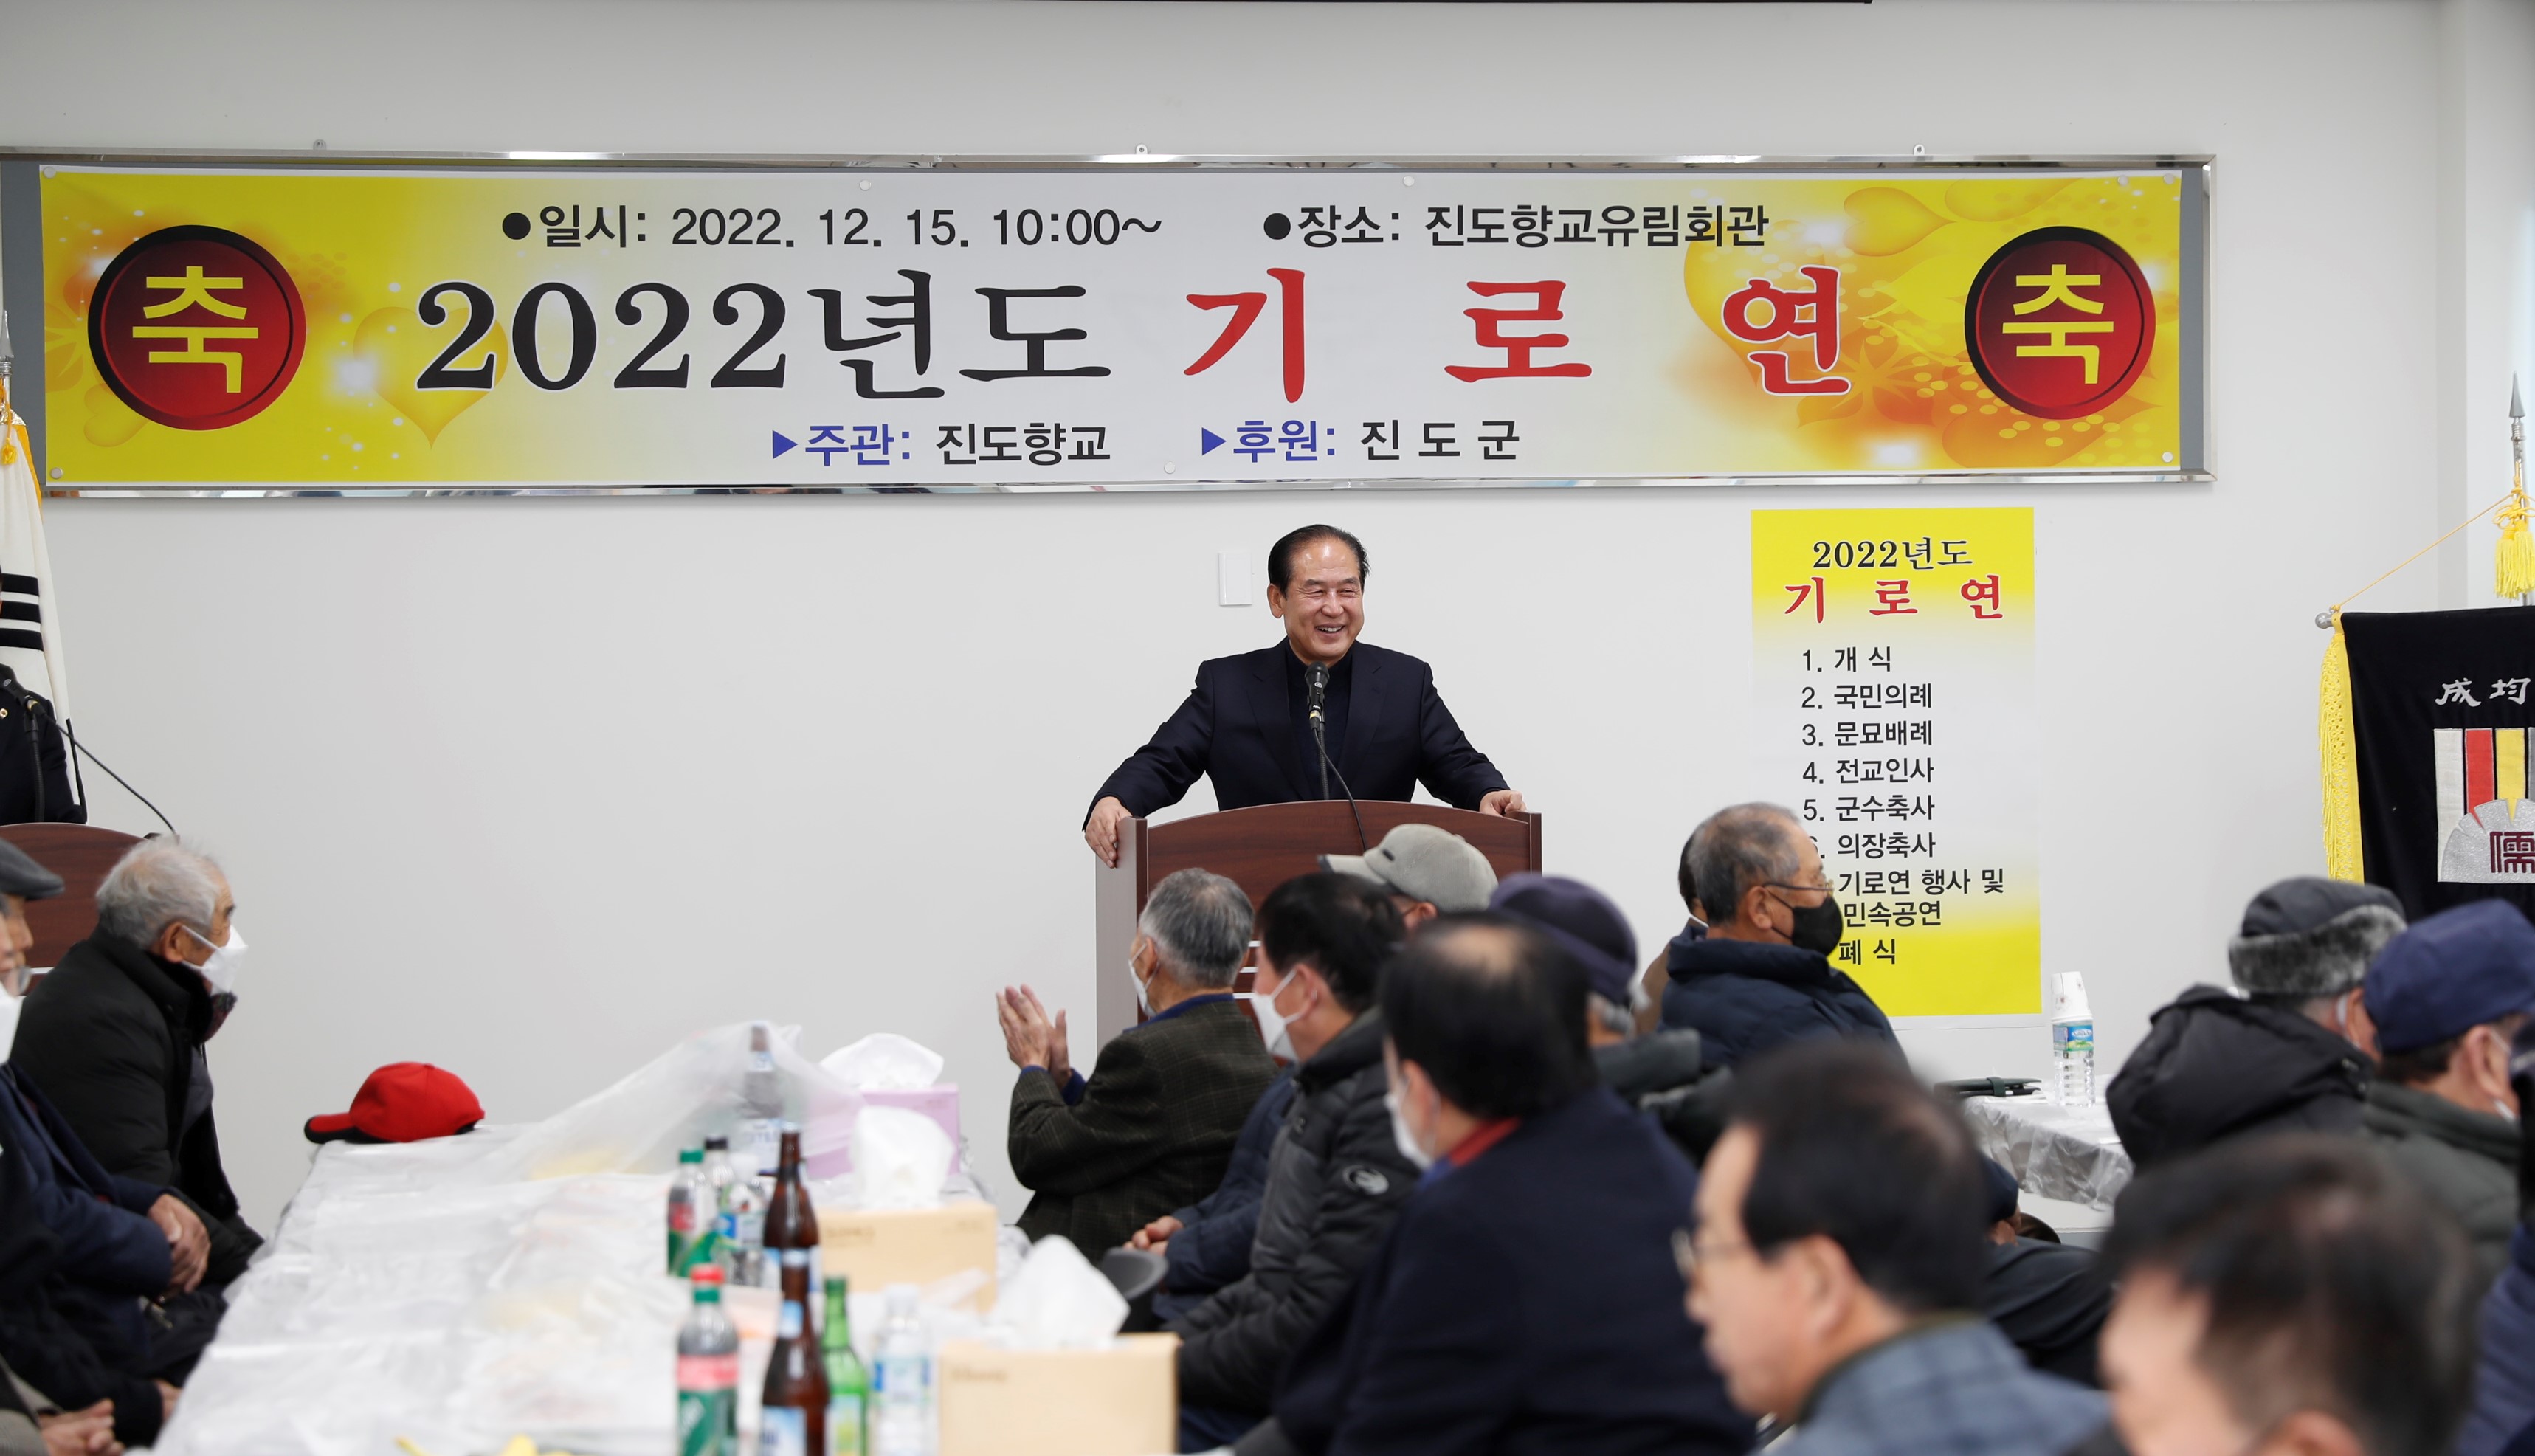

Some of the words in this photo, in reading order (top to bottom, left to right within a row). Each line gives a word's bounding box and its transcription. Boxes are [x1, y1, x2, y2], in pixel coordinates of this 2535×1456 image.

[539, 204, 646, 249] 일시:
[672, 207, 794, 248] 2022.
[819, 207, 882, 247] 12.
[906, 209, 969, 248] 15.
[993, 208, 1162, 246] 10:00~
[1297, 204, 1399, 248] 장소:
[1425, 204, 1770, 248] 진도향교유림회관
[131, 265, 260, 394] 축
[416, 269, 1111, 399] 2022년도
[2001, 263, 2114, 384] 축
[806, 424, 910, 466] 주관:
[936, 422, 1111, 466] 진도향교
[1233, 420, 1335, 463] 후원:
[1813, 536, 1973, 570] 2022년도
[1803, 649, 1822, 672] 1.
[1801, 686, 1823, 709] 2.
[1834, 683, 1931, 710] 국민의례
[1802, 723, 1824, 747] 3.
[1835, 720, 1932, 747] 문묘배례
[1802, 761, 1824, 784] 4.
[1836, 757, 1934, 784] 전교인사
[1804, 798, 1824, 821] 5.
[1835, 794, 1935, 821] 군수축사
[1838, 832, 1936, 859] 의장축사
[1838, 869, 1910, 897] 기로연
[1922, 869, 1971, 895] 행사
[1982, 868, 2004, 894] 및
[1844, 900, 1941, 928] 민속공연
